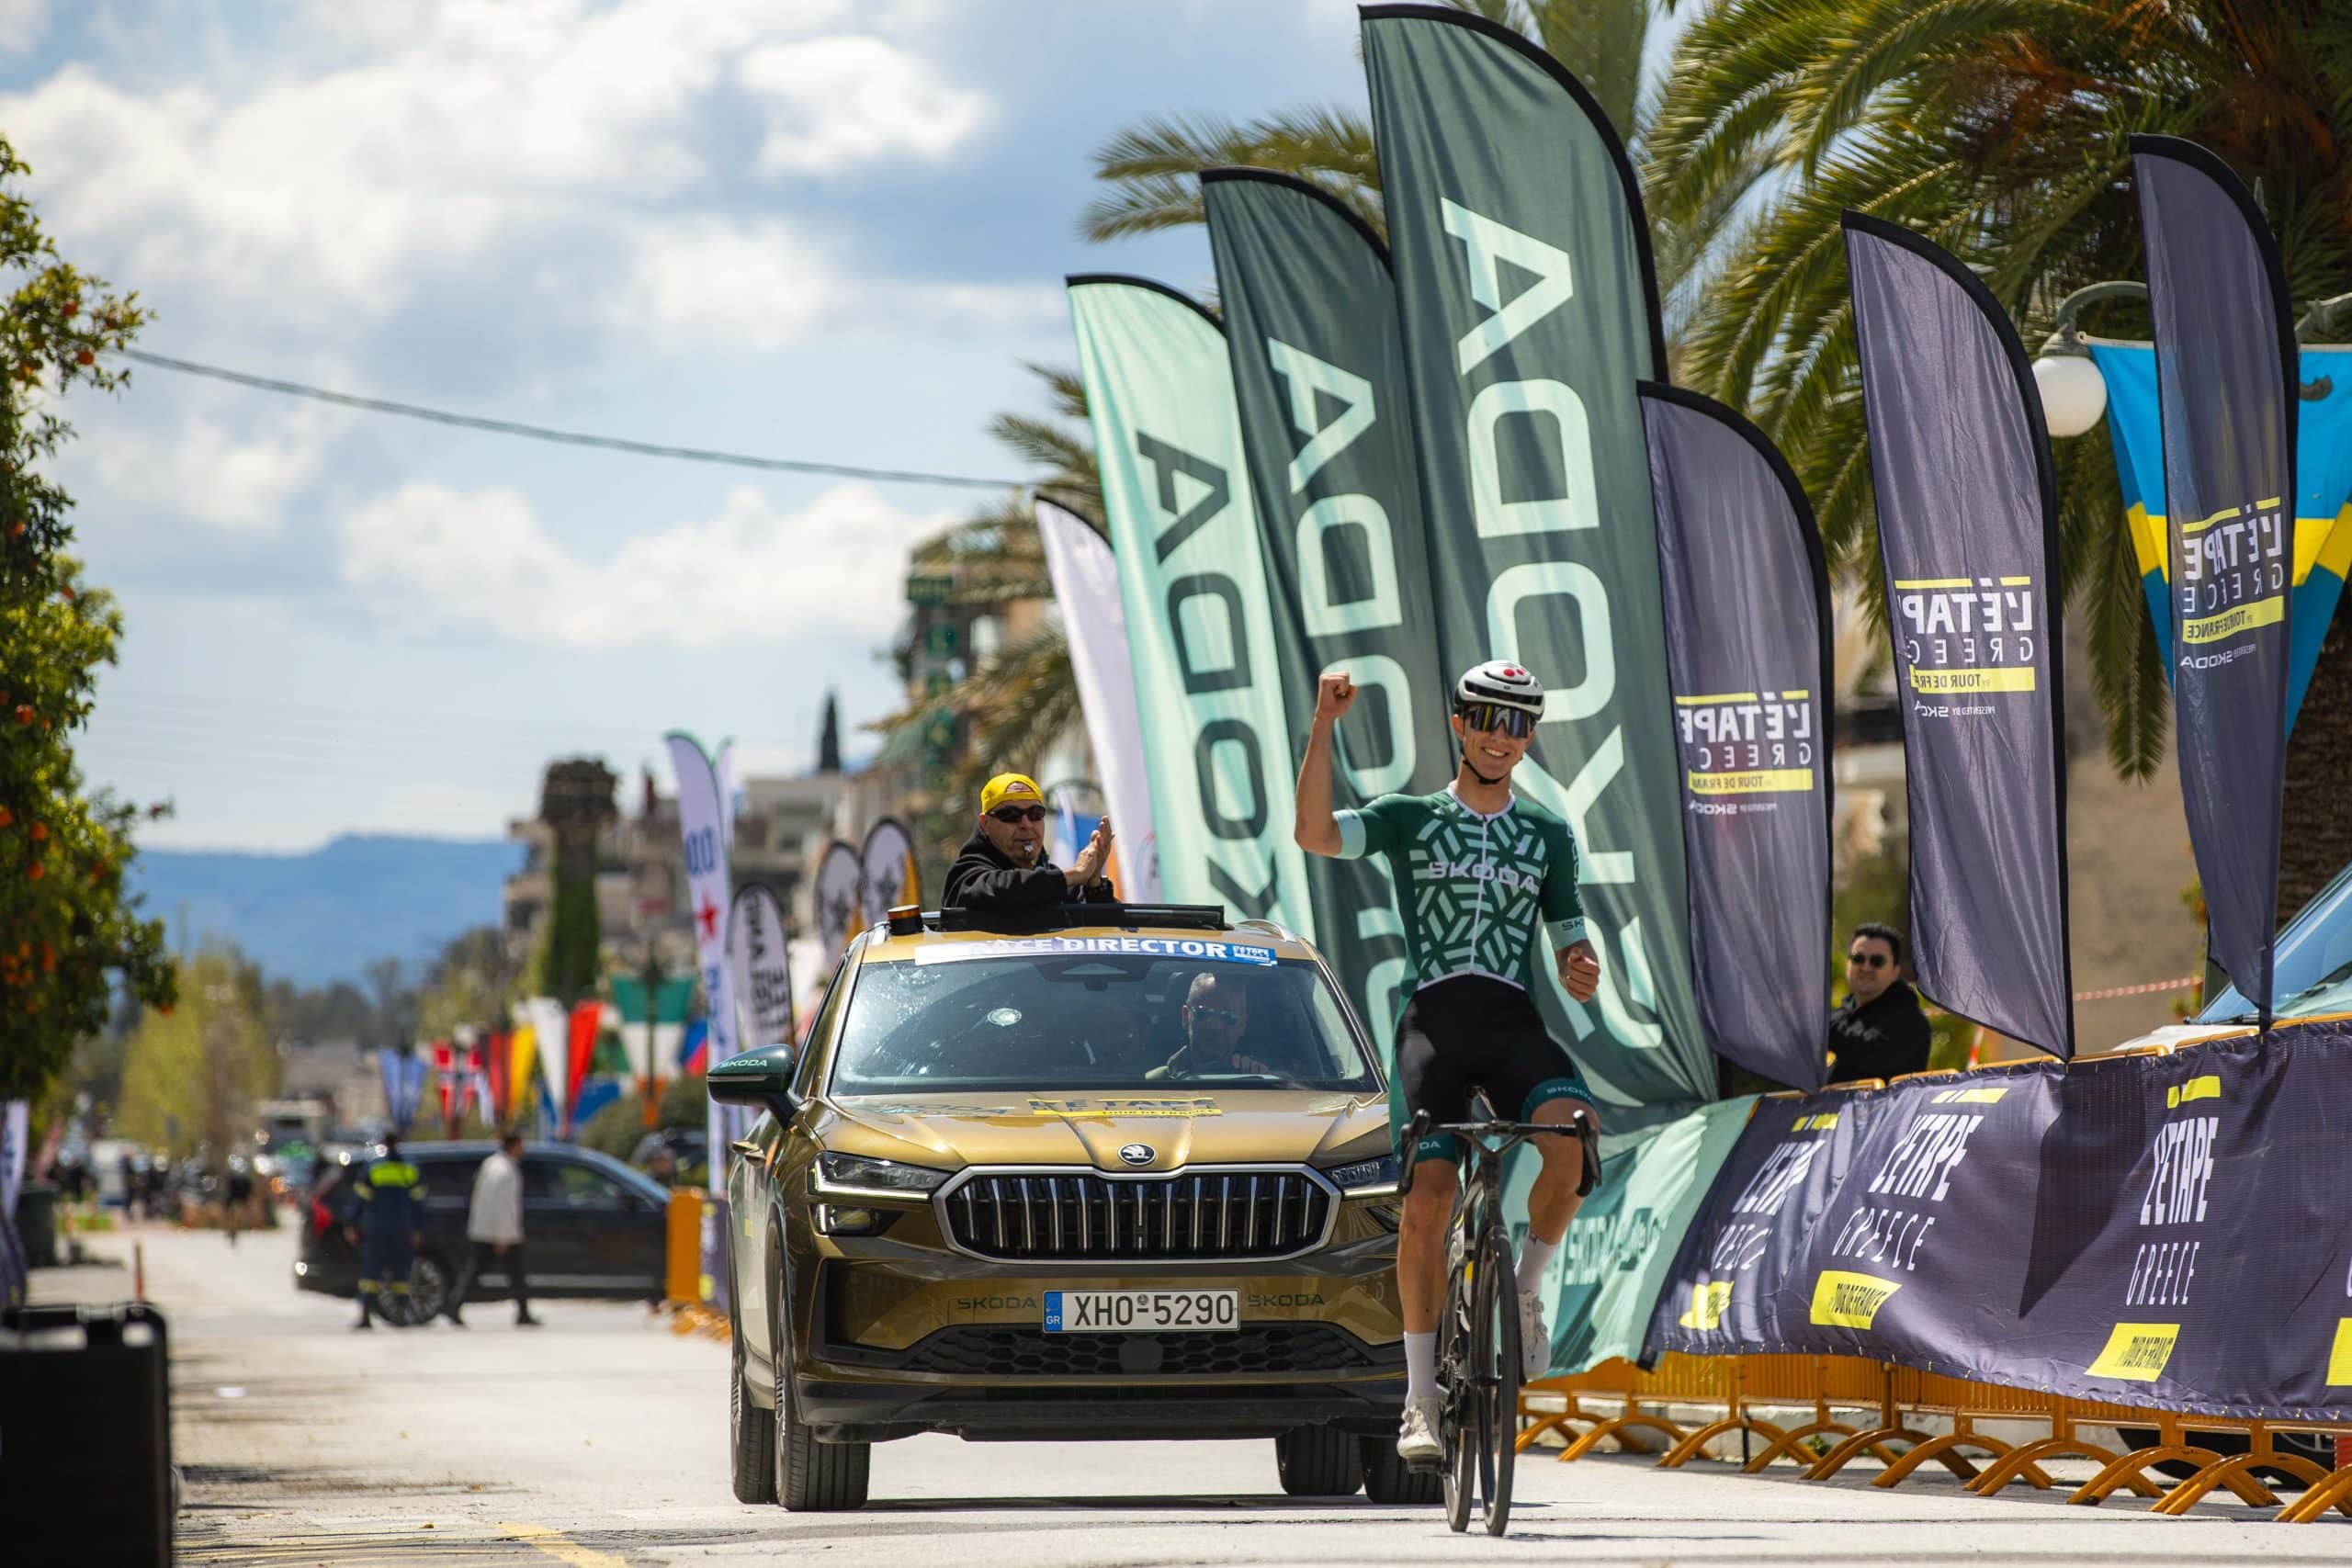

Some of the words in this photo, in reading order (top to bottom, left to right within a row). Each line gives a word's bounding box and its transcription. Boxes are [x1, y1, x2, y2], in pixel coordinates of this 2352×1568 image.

[1061, 937, 1227, 958] DIRECTOR
[956, 1297, 1037, 1310] SKODA
[1248, 1292, 1326, 1307] SKODA
[1046, 1315, 1061, 1325] GR
